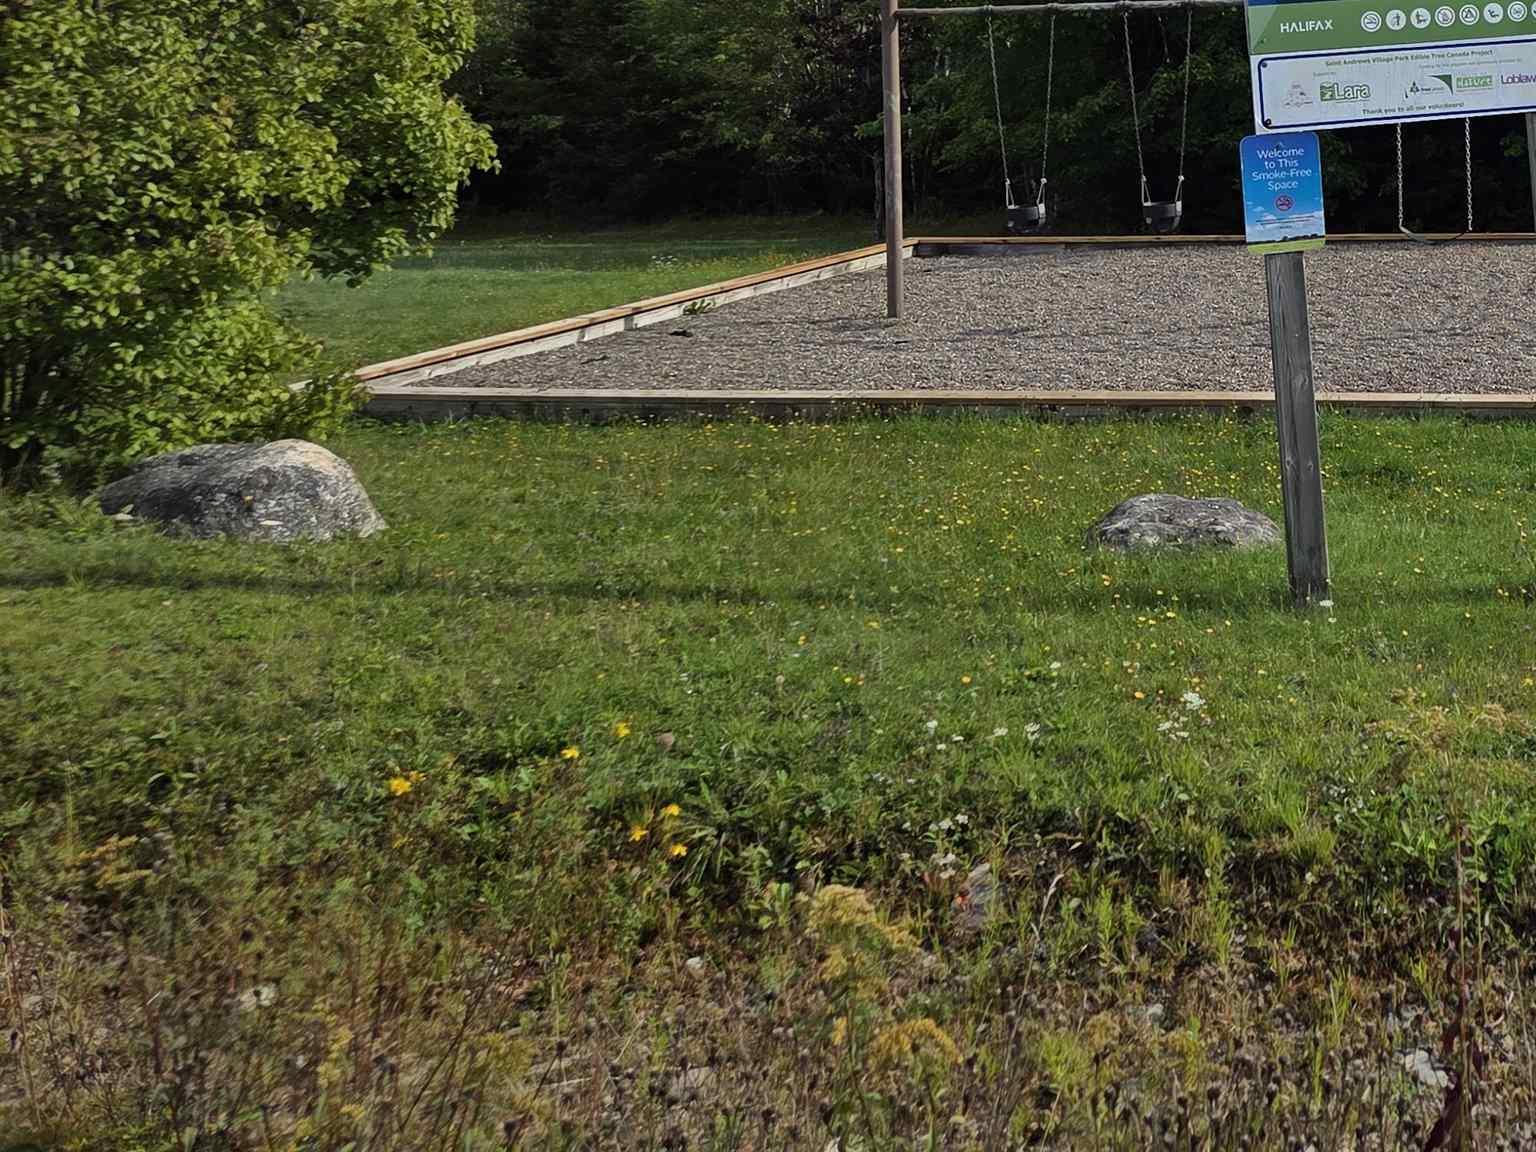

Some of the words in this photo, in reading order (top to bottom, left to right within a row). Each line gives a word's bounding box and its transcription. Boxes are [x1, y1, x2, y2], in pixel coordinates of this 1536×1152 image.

[1280, 19, 1334, 33] HALIFAX
[1500, 73, 1536, 85] Loblaw
[1333, 82, 1371, 100] Lara
[1256, 147, 1305, 159] Welcome
[1264, 160, 1276, 169] to
[1277, 158, 1299, 168] This
[1252, 168, 1313, 181] Smoke-Free
[1268, 180, 1299, 192] Space
